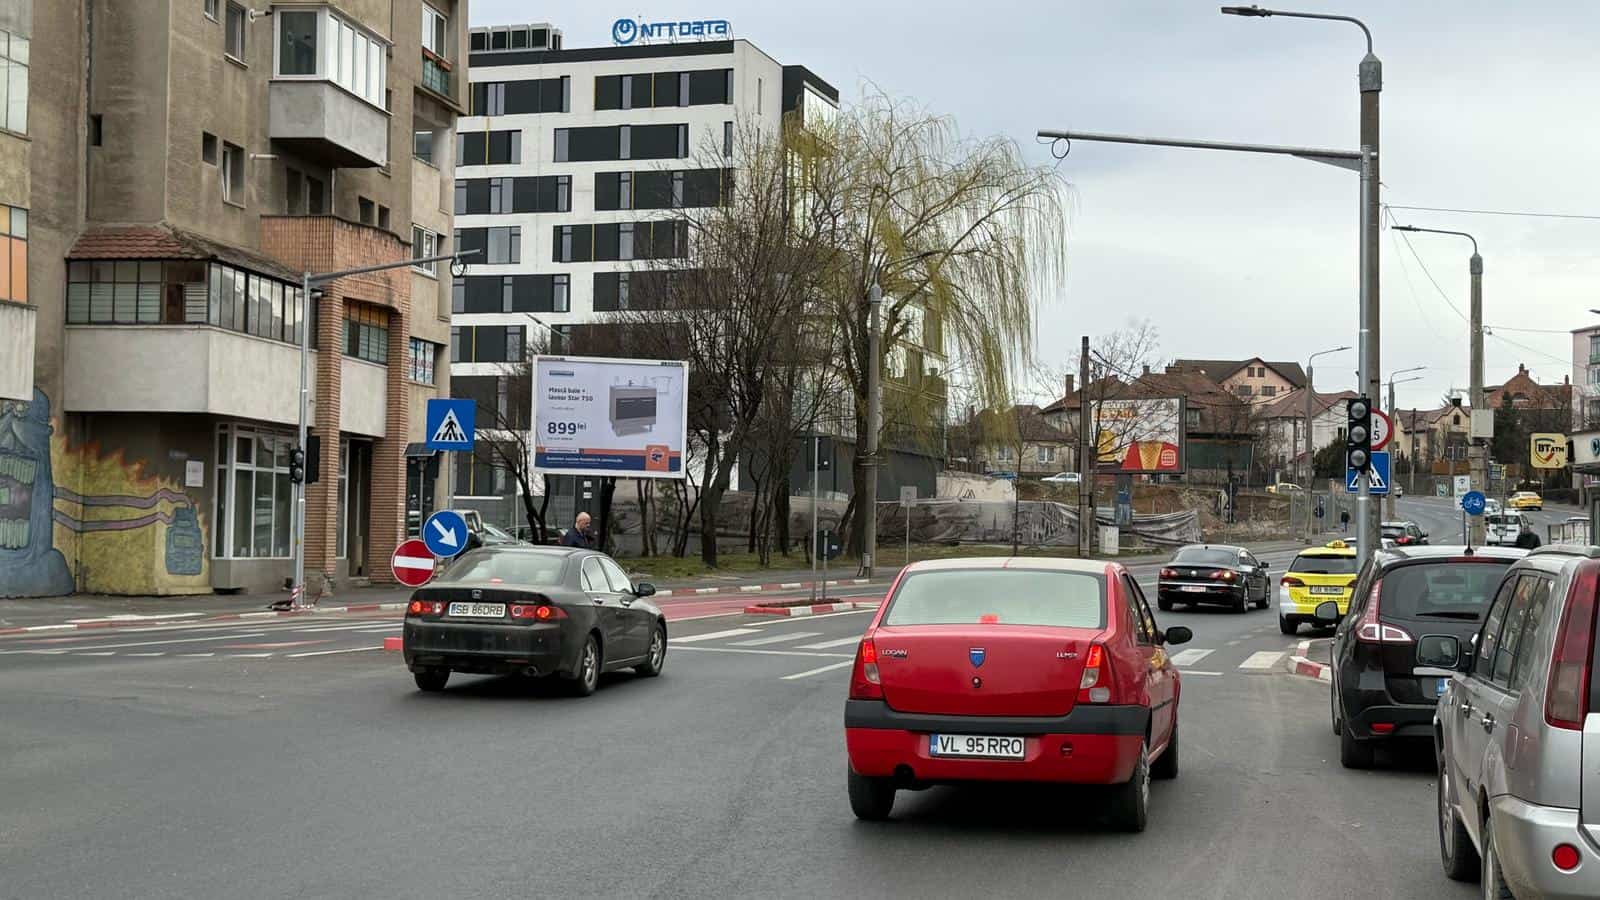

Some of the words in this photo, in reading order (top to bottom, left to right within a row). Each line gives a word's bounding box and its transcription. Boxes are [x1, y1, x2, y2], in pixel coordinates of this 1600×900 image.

[641, 23, 677, 37] NTT
[547, 422, 577, 435] 899
[1538, 444, 1551, 452] BT
[456, 604, 469, 614] SB
[940, 736, 960, 752] VL
